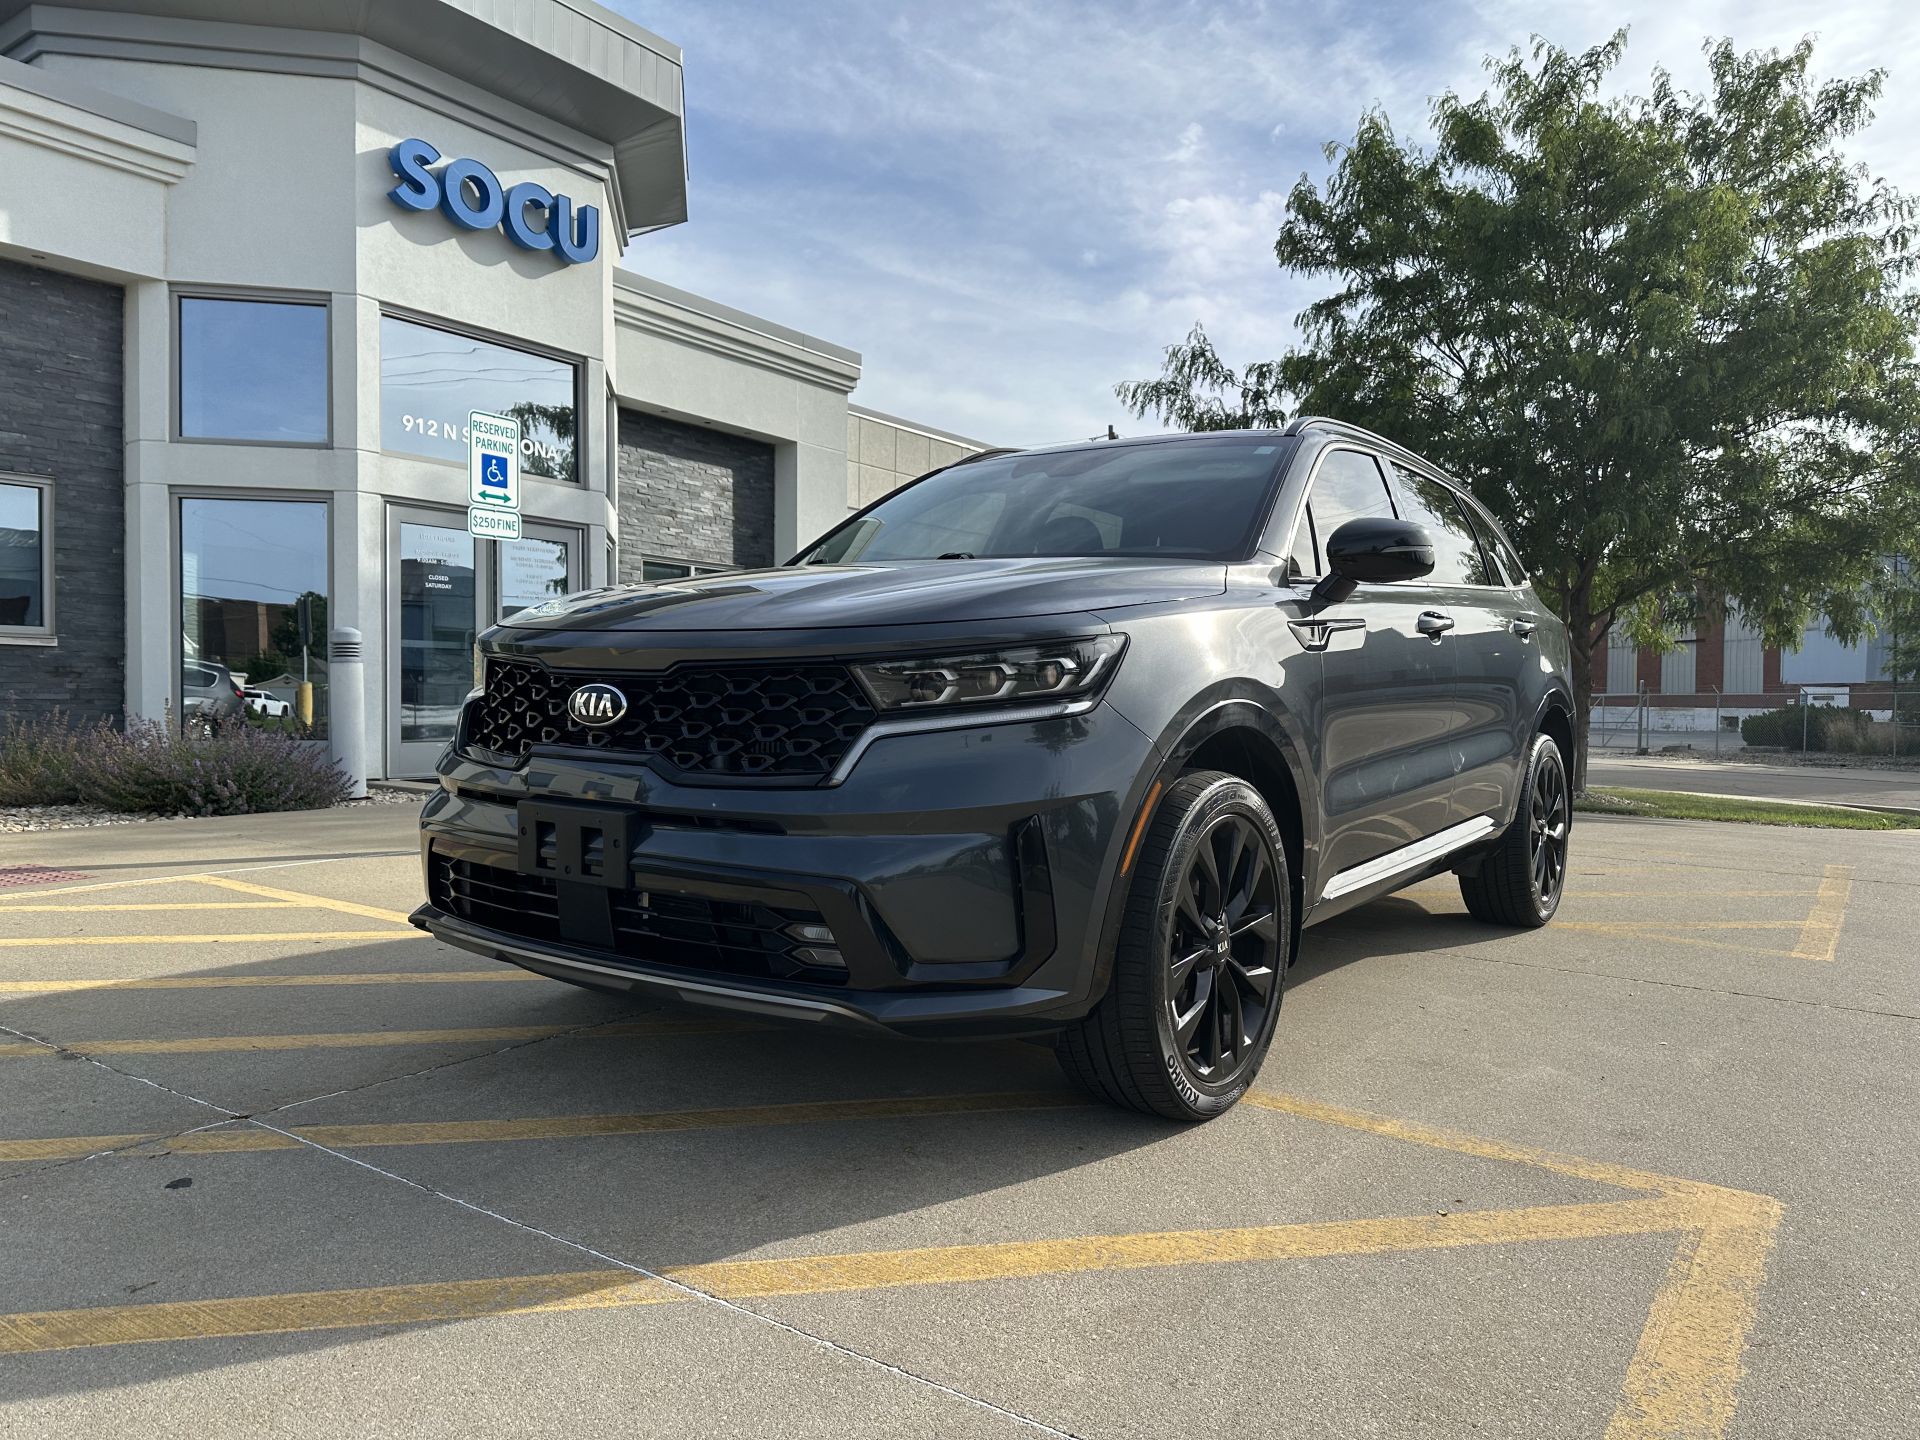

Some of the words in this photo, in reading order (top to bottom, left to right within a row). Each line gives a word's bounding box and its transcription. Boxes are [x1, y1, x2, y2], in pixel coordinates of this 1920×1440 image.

[387, 138, 599, 265] SOCU
[402, 414, 438, 437] 912
[443, 422, 457, 441] N
[472, 420, 516, 440] RESERVED
[475, 436, 513, 455] PARKING
[472, 514, 496, 529] $250
[497, 518, 518, 532] FINE
[424, 582, 453, 590] SATURDAY
[428, 574, 449, 582] CLOSED
[574, 692, 614, 717] KIA
[1167, 1054, 1200, 1106] KUMHO
